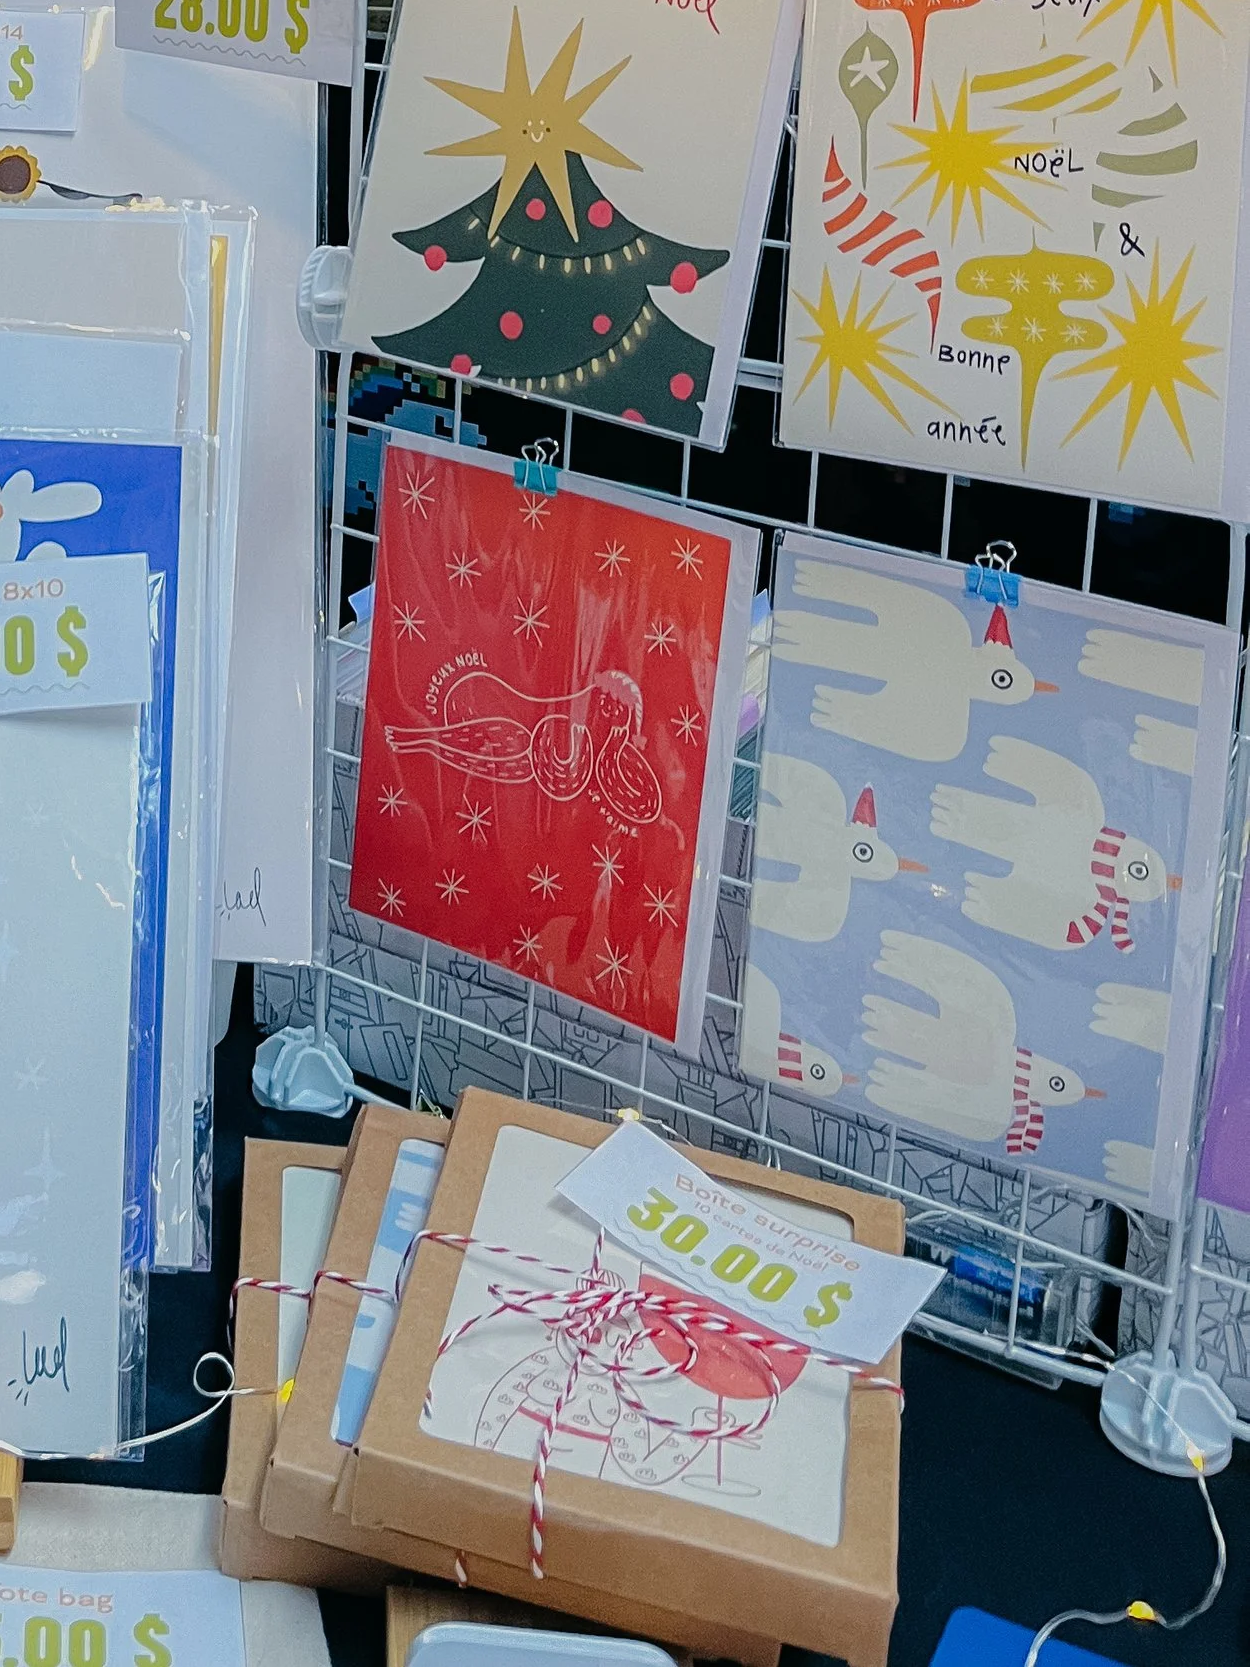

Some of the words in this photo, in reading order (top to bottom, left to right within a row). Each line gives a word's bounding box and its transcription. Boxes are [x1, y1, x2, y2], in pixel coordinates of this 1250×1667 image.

[8, 44, 35, 101] $
[1118, 221, 1146, 258] &
[927, 415, 1006, 446] année
[3, 578, 64, 601] 8x10
[56, 605, 89, 678] $
[675, 1172, 747, 1216] Boîte
[753, 1212, 861, 1272] surprise
[693, 1200, 712, 1215] 10
[712, 1214, 763, 1246] cartes
[765, 1241, 786, 1257] de
[787, 1250, 830, 1273] Noël
[626, 1186, 799, 1303] 30.00
[803, 1280, 854, 1328] $
[58, 1587, 114, 1614] bag
[133, 1613, 173, 1667] $
